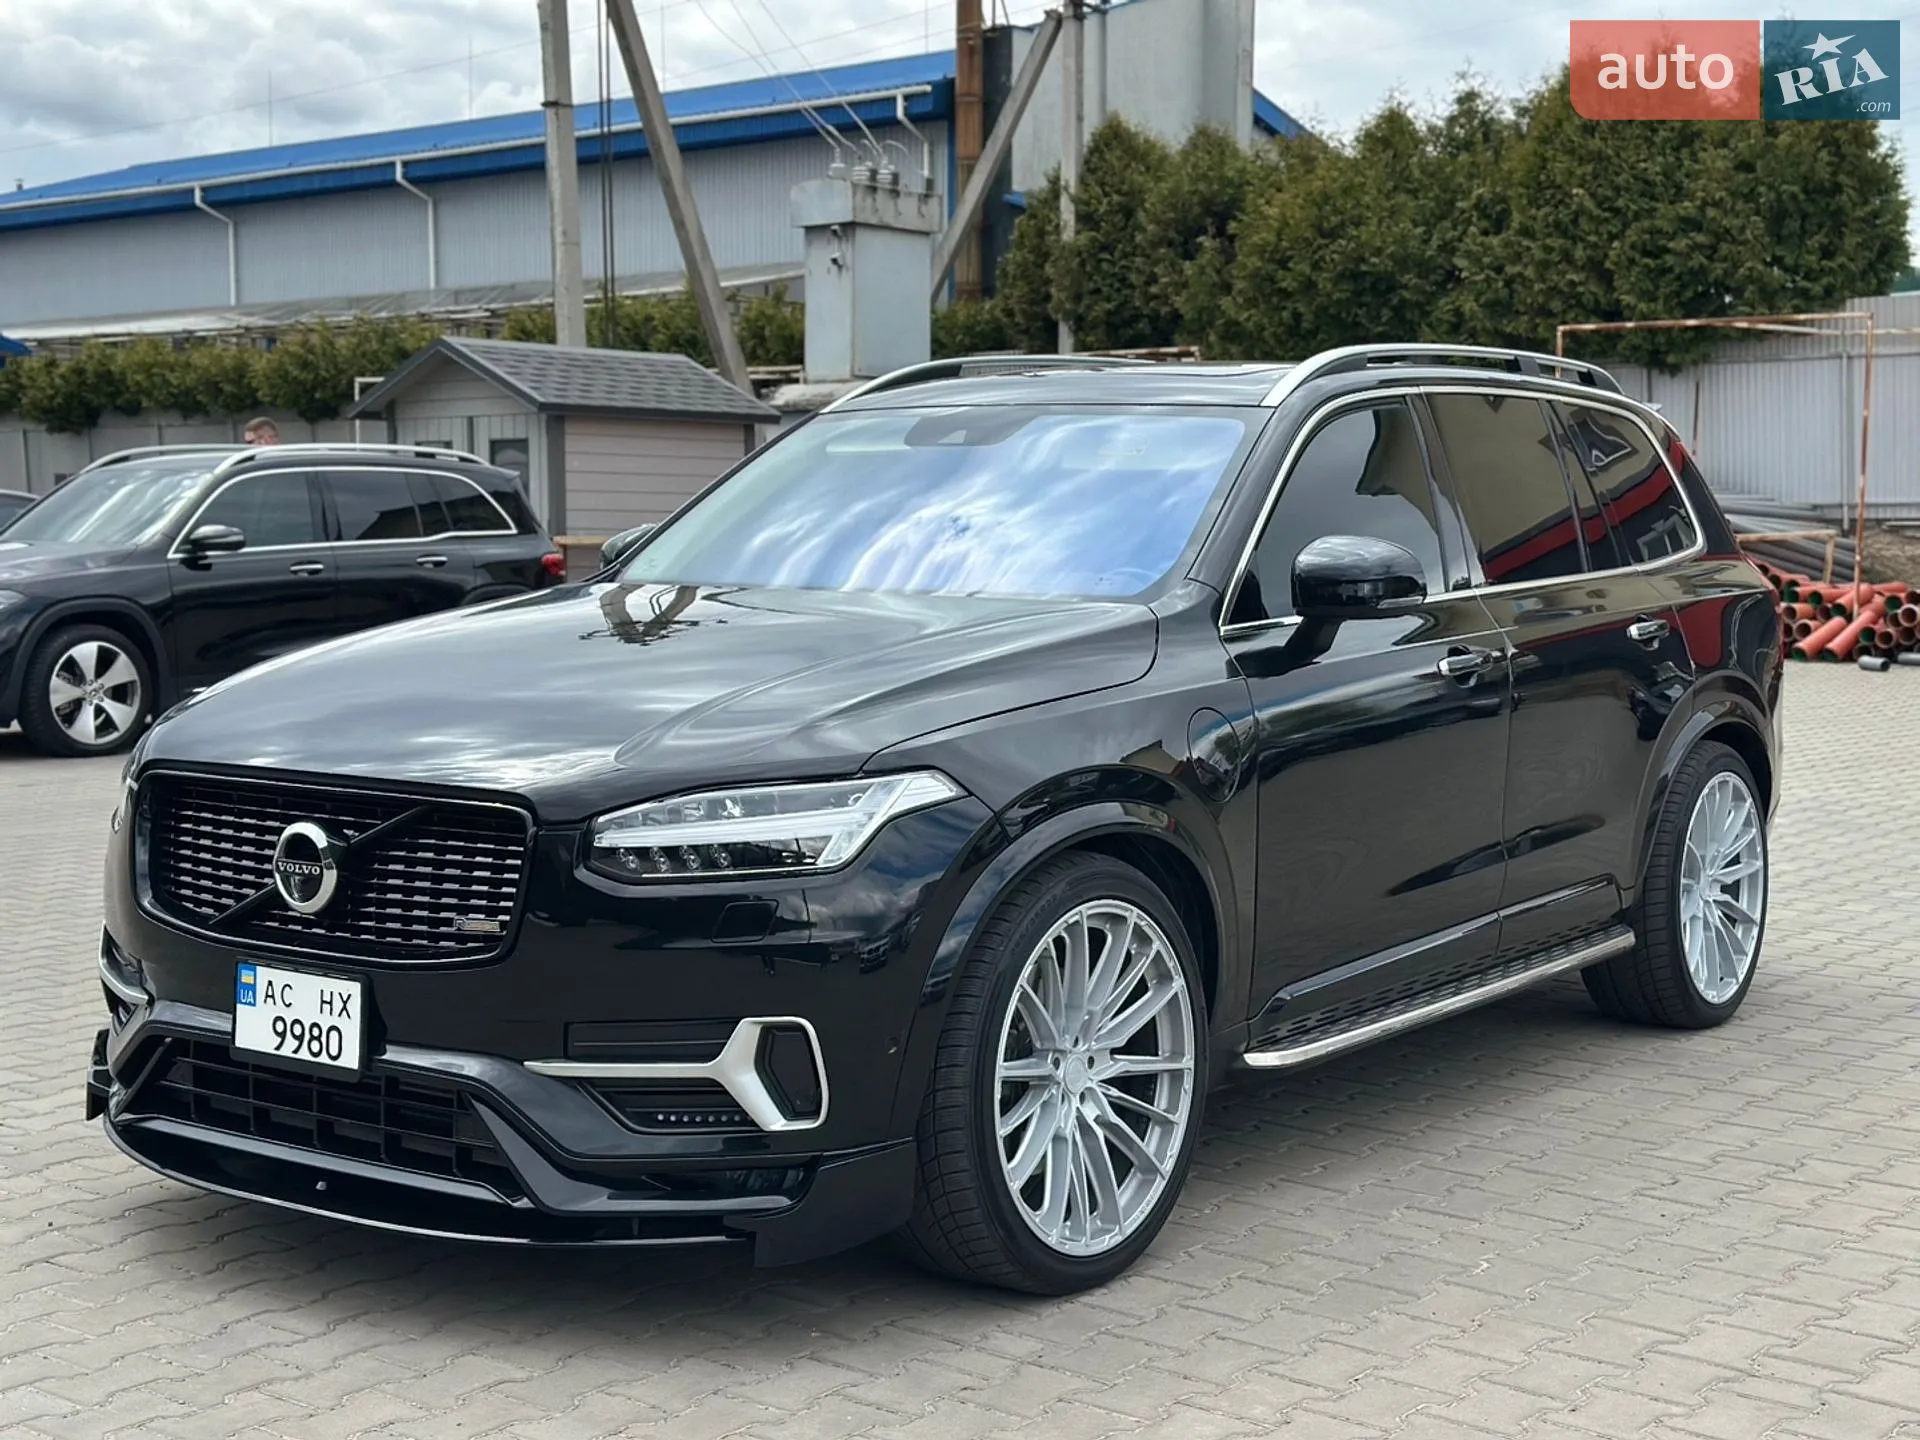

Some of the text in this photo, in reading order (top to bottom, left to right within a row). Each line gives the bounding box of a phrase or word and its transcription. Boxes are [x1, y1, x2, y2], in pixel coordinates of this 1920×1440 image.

[277, 861, 321, 876] VOLVO
[240, 989, 254, 1005] UA
[264, 980, 351, 1019] AC HX
[272, 1015, 342, 1061] 9980
